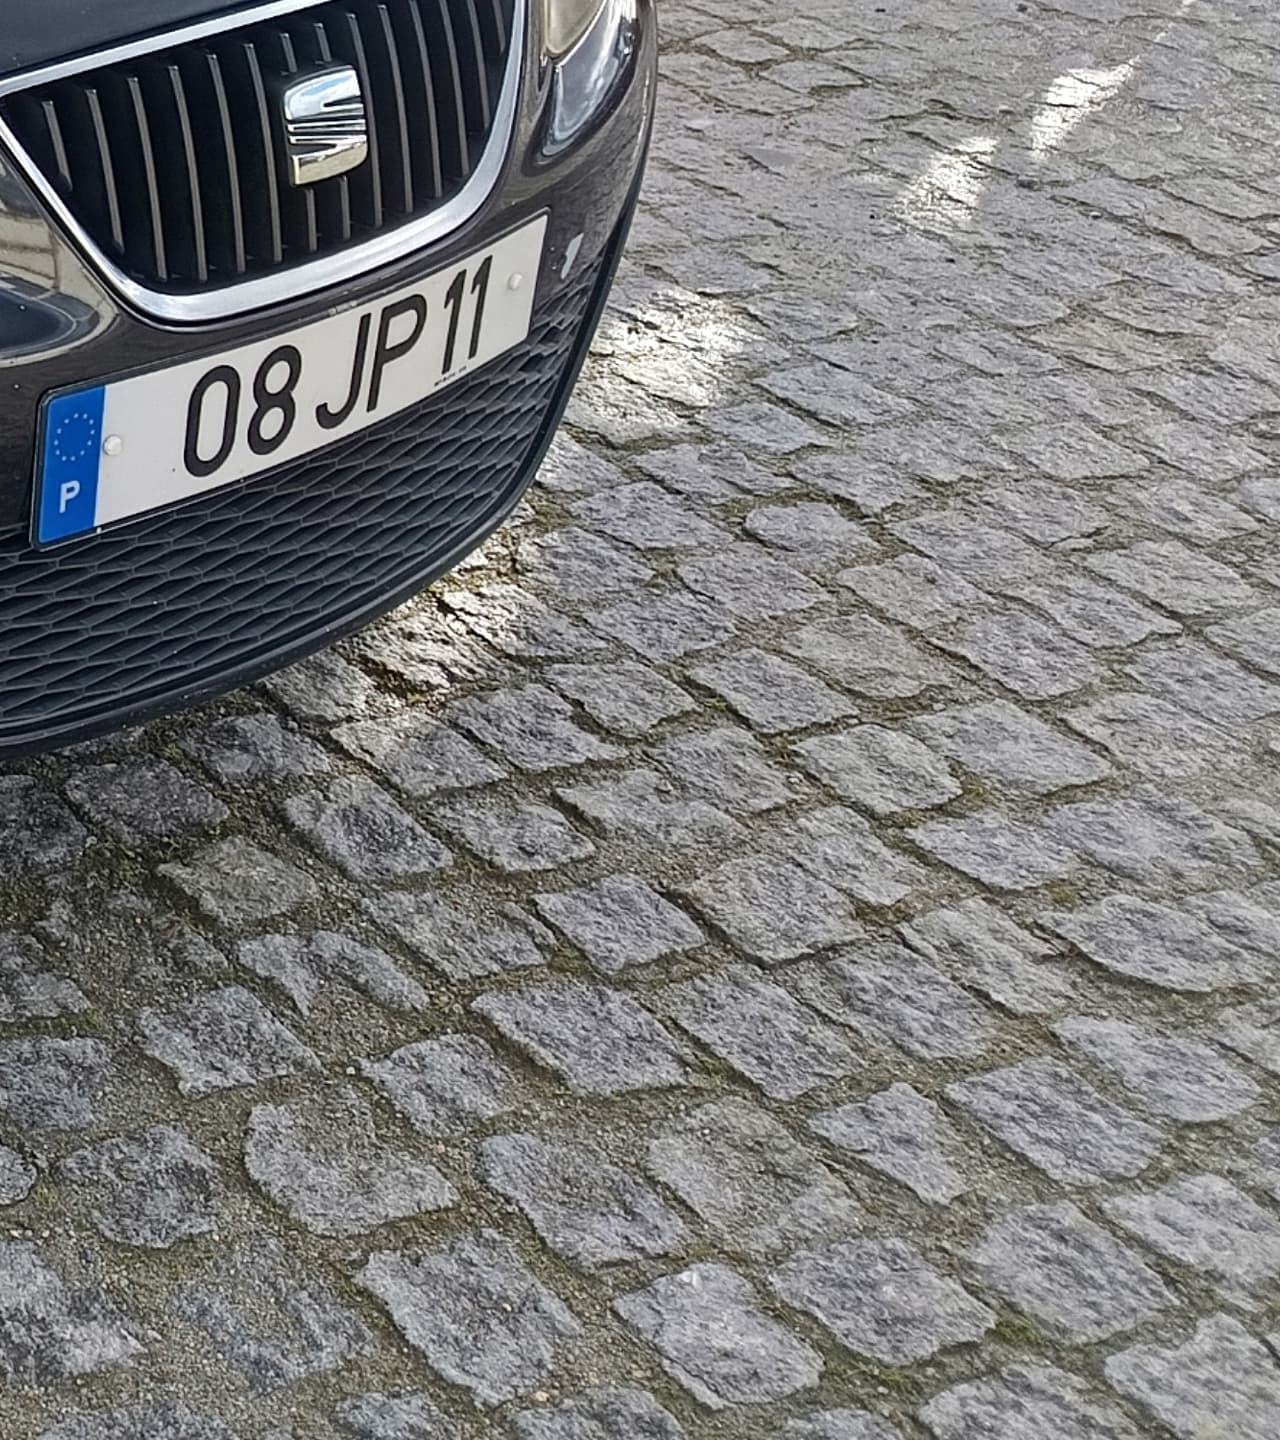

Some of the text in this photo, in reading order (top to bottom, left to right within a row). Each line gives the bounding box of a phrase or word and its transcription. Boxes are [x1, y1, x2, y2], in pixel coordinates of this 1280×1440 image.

[182, 254, 494, 479] 08 JP 11
[58, 479, 82, 514] P
